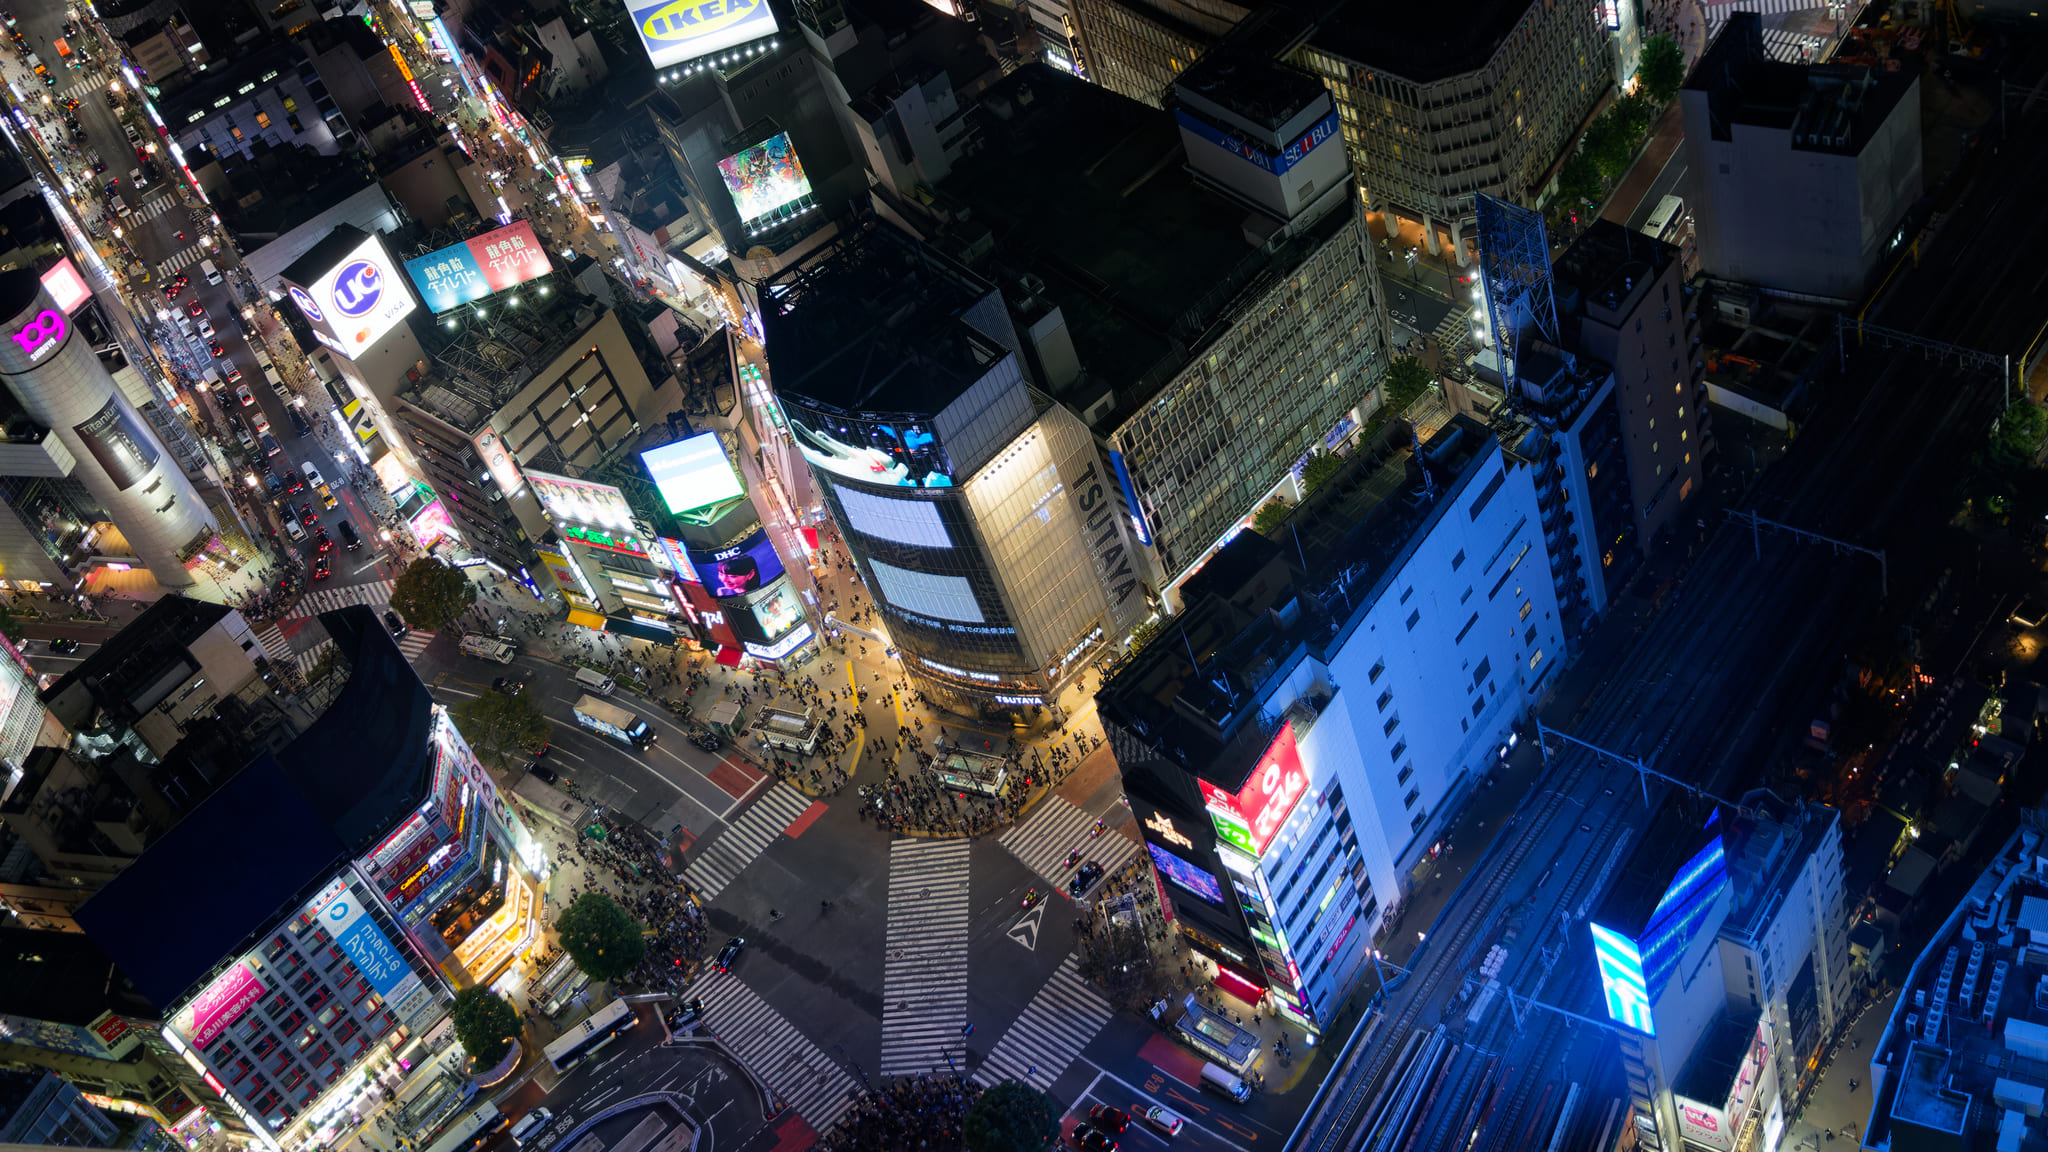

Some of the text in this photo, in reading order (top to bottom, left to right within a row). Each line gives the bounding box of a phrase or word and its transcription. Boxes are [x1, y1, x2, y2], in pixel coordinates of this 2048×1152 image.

[651, 0, 754, 36] IKEA
[1284, 120, 1332, 166] SEIBU
[485, 235, 527, 259] 龍角散
[424, 257, 465, 281] 龍角散
[384, 300, 405, 319] VISA
[79, 402, 120, 435] Titanium
[1072, 461, 1138, 606] TSUTAYA
[714, 546, 741, 561] DHC
[1060, 627, 1103, 666] TSUTAYA
[994, 695, 1043, 705] TSUTAYA
[392, 895, 405, 909] 7F
[345, 933, 389, 981] アイシティ
[360, 923, 401, 971] コンタクトの
[203, 985, 261, 1040] 品川美容外科
